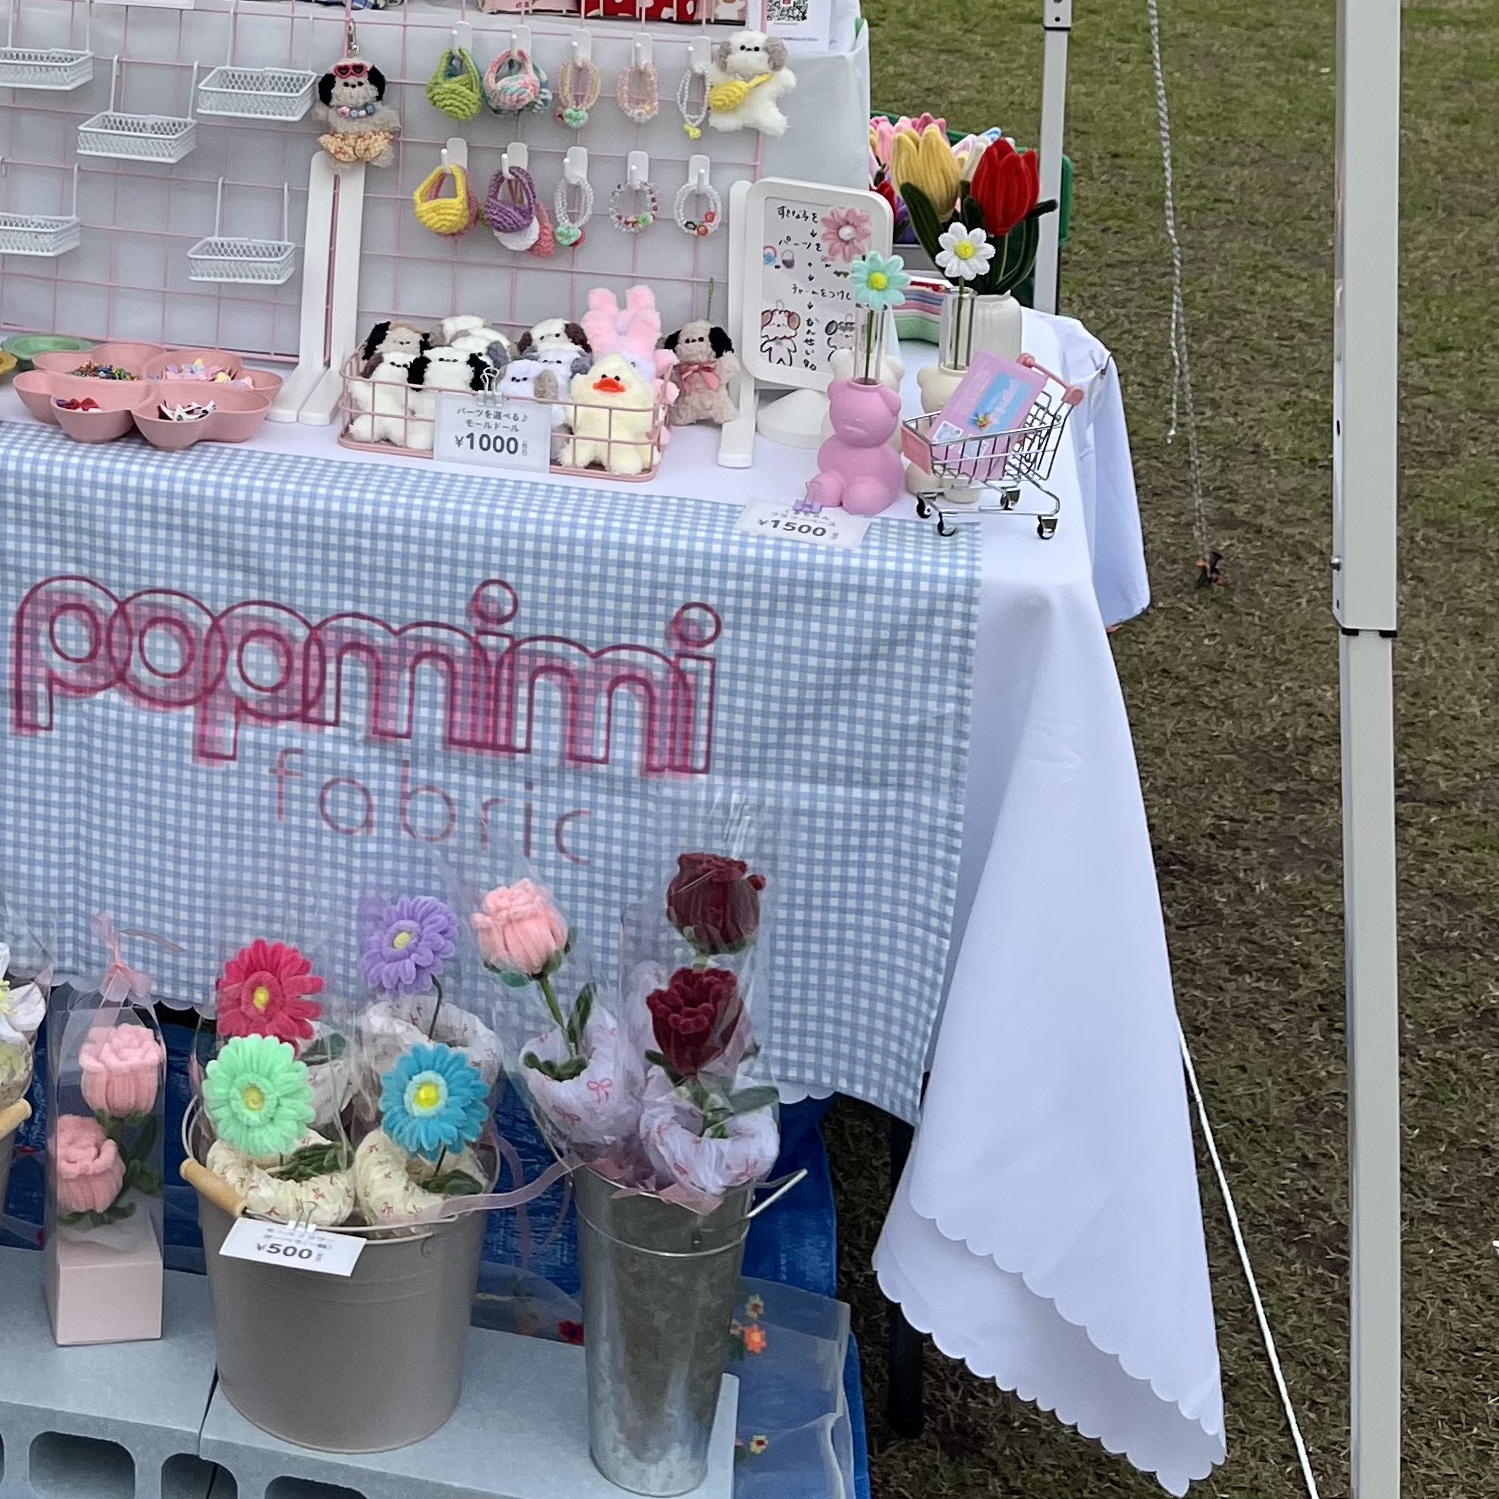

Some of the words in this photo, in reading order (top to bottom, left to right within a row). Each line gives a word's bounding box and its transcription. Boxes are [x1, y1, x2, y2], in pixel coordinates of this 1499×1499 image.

[465, 419, 520, 433] モールドール
[454, 432, 519, 455] ¥1000
[758, 518, 827, 537] ¥1500
[12, 574, 722, 778] popmimi
[269, 747, 593, 864] fabric
[256, 1242, 313, 1260] ¥500
